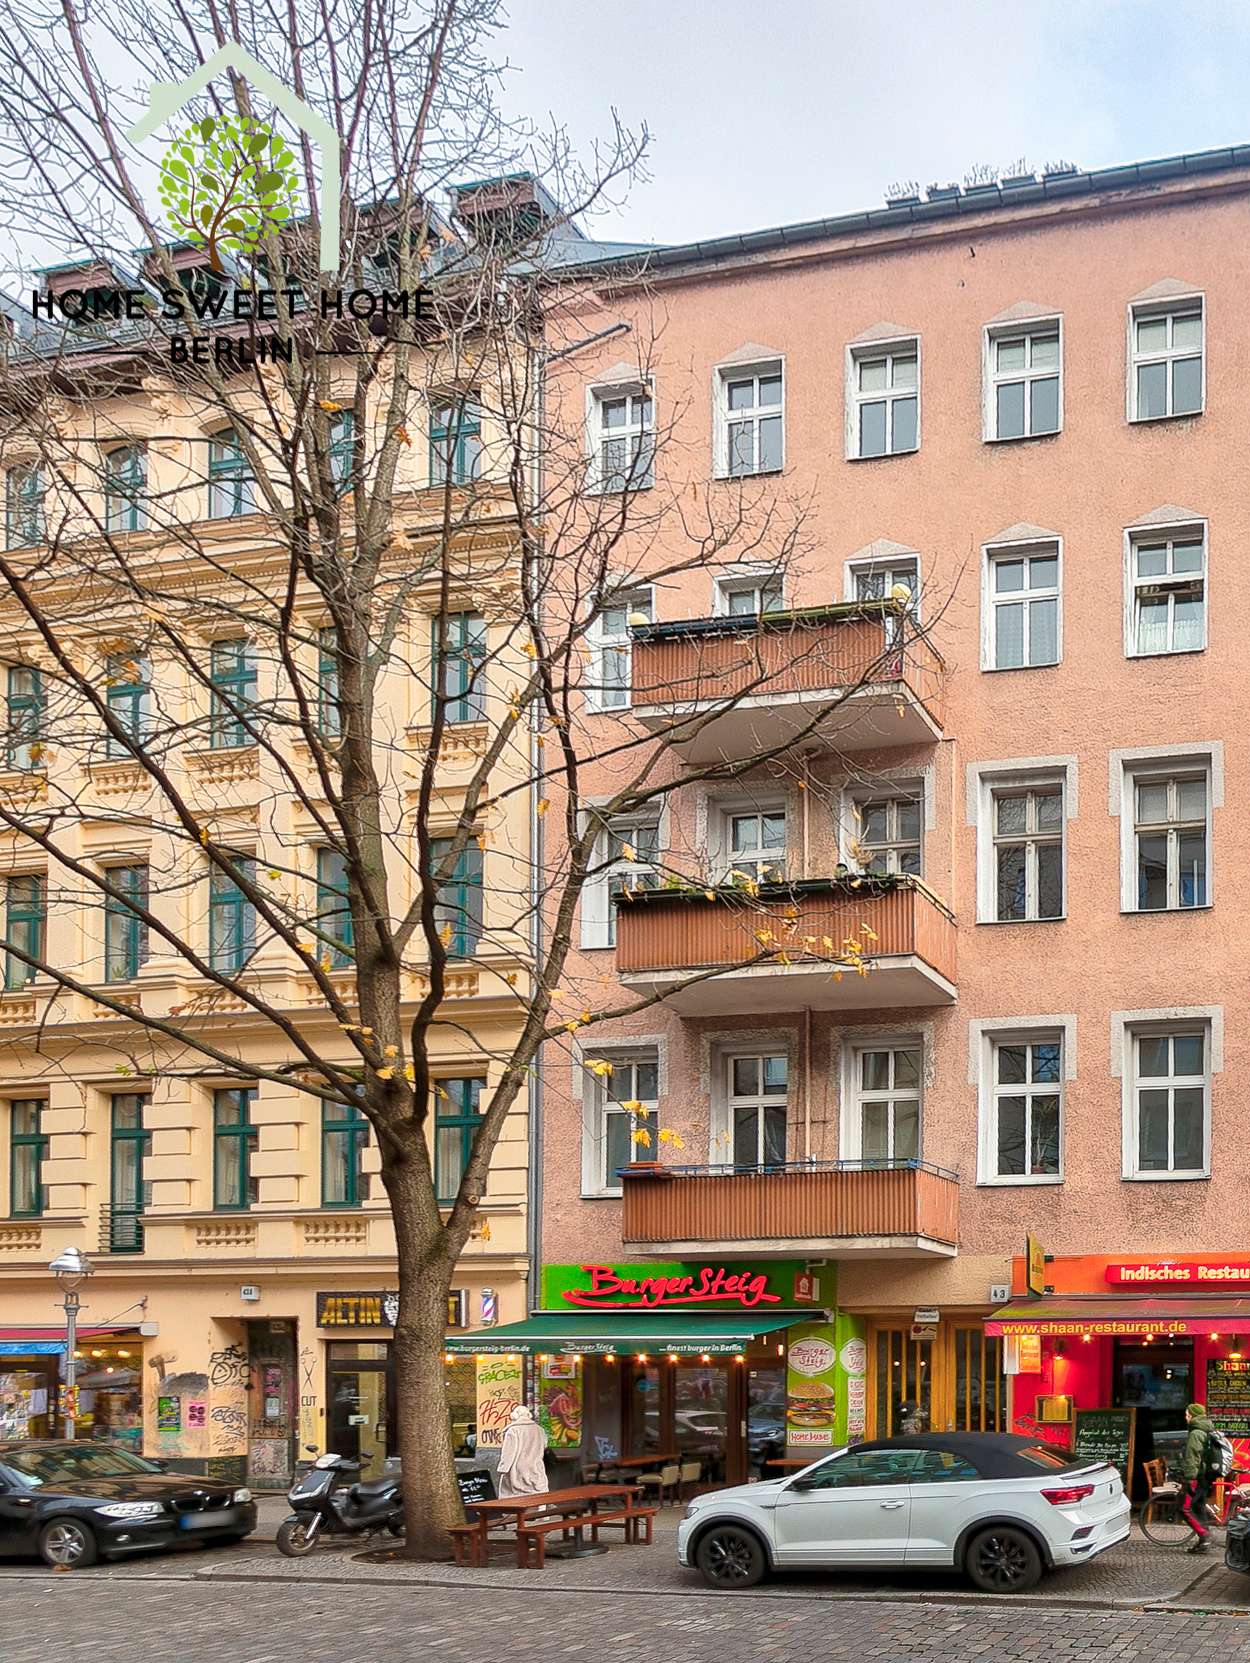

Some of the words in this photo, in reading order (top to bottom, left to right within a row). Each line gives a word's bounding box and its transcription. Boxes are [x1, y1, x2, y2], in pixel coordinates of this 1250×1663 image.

[1120, 1265, 1190, 1281] Indisches
[992, 1289, 1006, 1299] 43
[320, 1296, 382, 1325] ALTIN
[1002, 1321, 1187, 1335] www.shaan-restaurant.de
[687, 1344, 711, 1353] burger
[720, 1344, 743, 1352] Berlin
[301, 1395, 317, 1407] CUT
